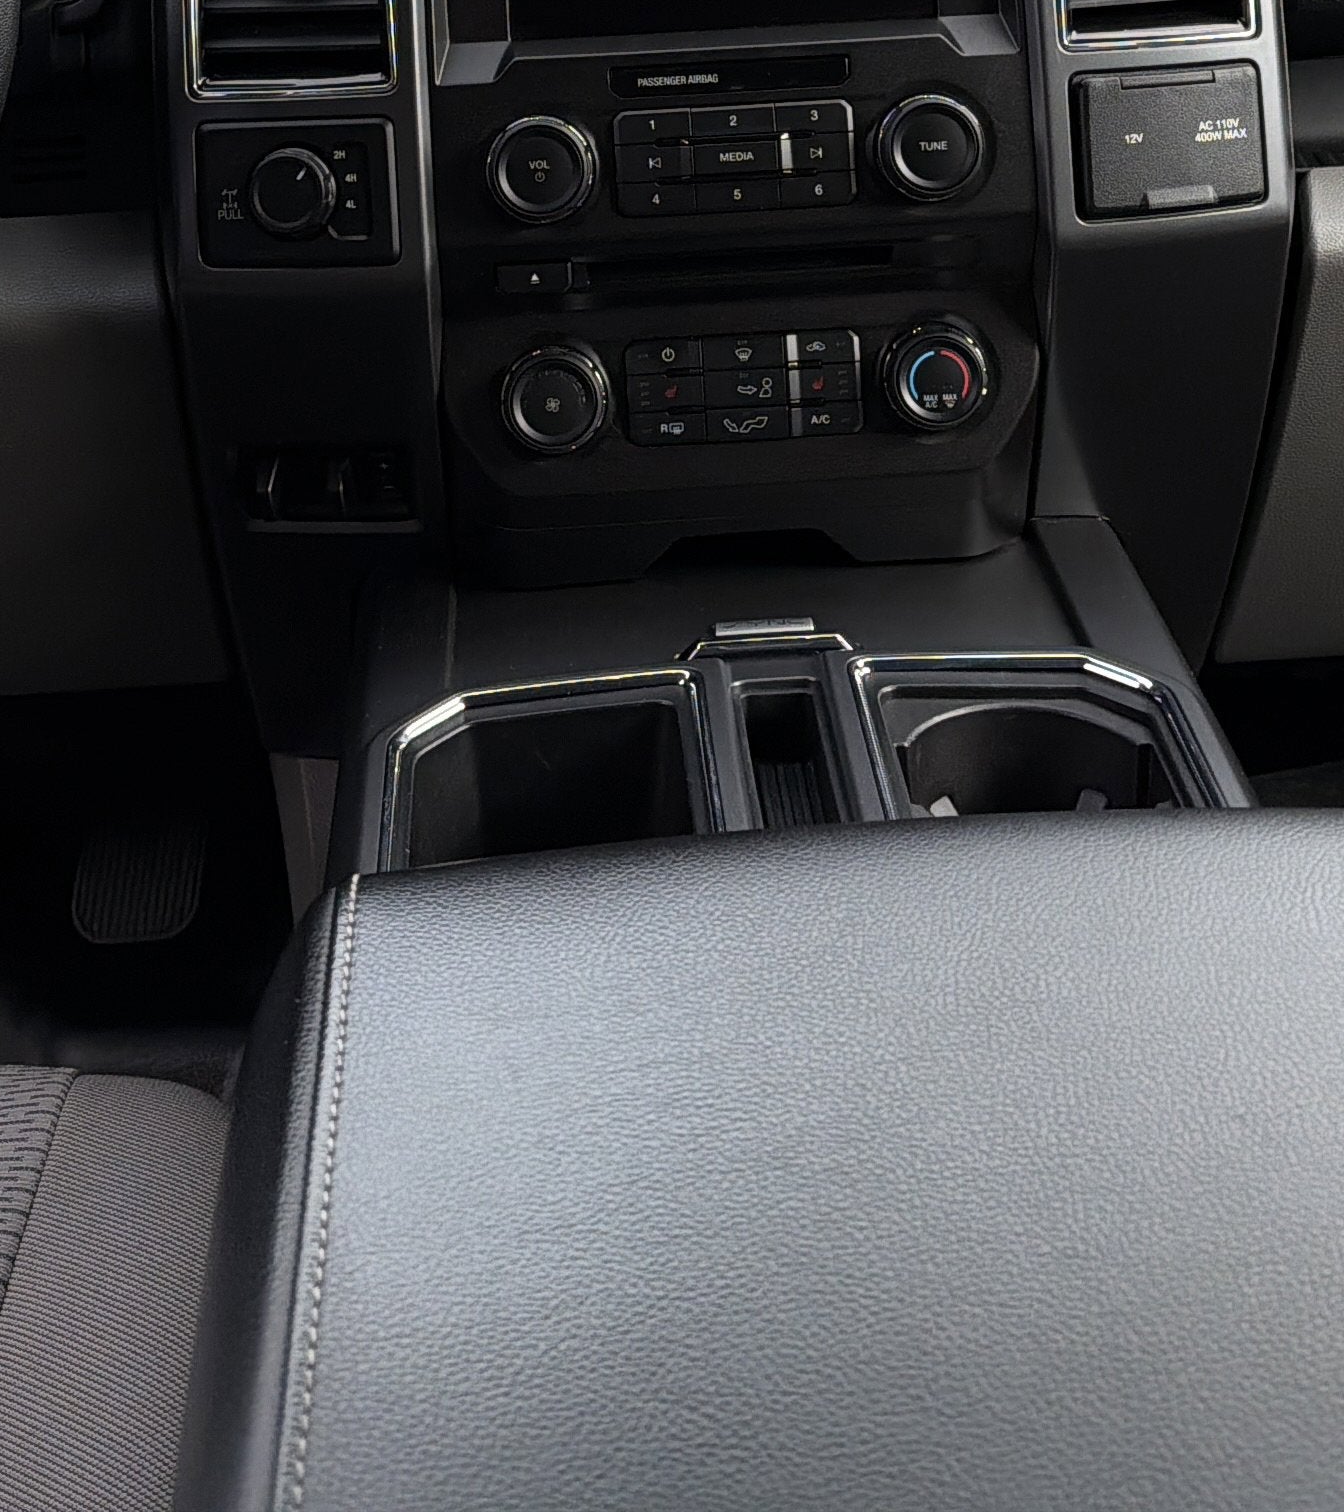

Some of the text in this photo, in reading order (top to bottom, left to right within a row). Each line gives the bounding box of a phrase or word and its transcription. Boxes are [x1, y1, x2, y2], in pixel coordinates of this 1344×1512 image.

[637, 74, 719, 87] PASSENGER AIRBAG
[729, 115, 737, 126] 2
[810, 109, 819, 121] 3
[648, 120, 655, 131] 1
[1199, 118, 1240, 131] AC 110V
[1125, 133, 1144, 144] 12V
[1195, 128, 1248, 143] 400W MAX
[919, 141, 948, 151] TUNE
[333, 150, 346, 160] 2H
[719, 151, 754, 162] MEDIA
[529, 160, 550, 170] VOL
[345, 173, 357, 183] 4H
[733, 188, 742, 200] 5
[815, 184, 823, 196] 6
[345, 199, 357, 209] 4L
[652, 193, 660, 205] 4
[218, 209, 244, 220] PULL
[811, 414, 830, 425] A/C
[661, 423, 669, 433] R
